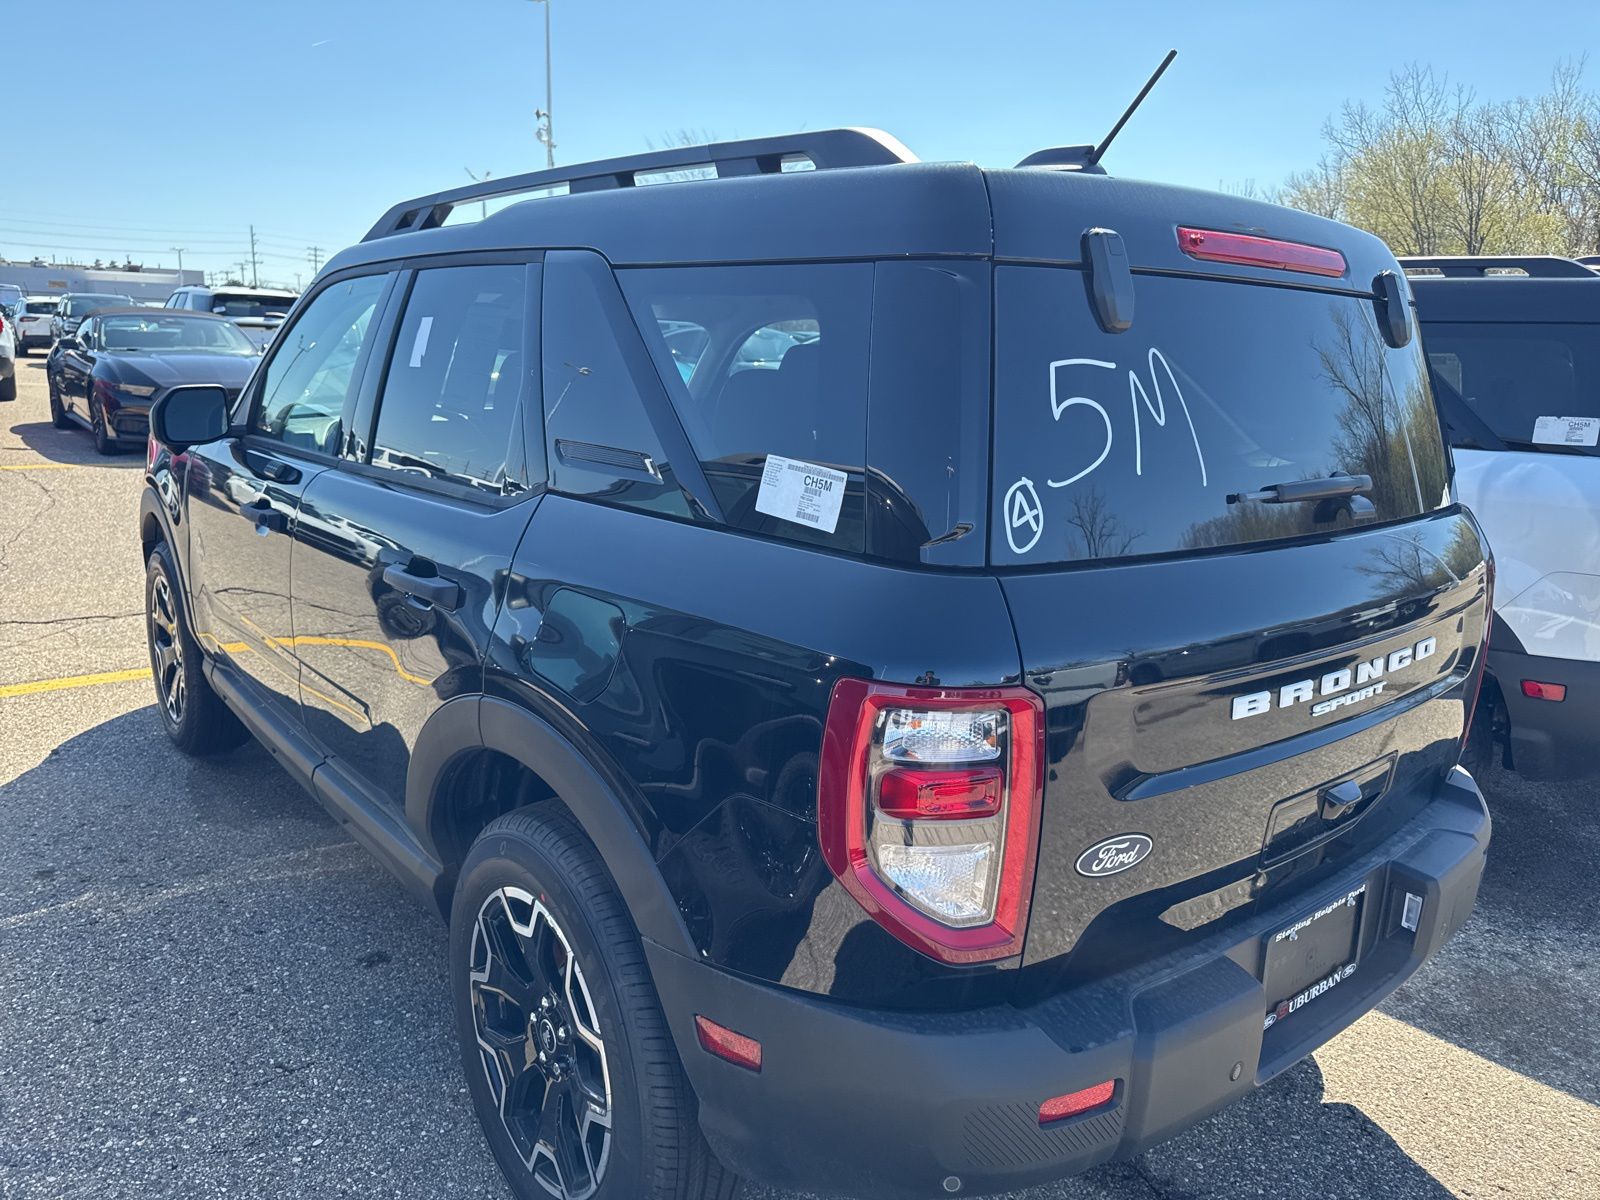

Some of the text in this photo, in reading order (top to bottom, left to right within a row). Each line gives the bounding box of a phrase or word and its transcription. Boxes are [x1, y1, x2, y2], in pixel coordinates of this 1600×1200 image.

[1047, 347, 1207, 488] 5M
[803, 475, 833, 492] CH5M
[1231, 636, 1437, 721] BRONCO
[1311, 681, 1387, 717] SPORT
[1275, 884, 1366, 942] Sterling Heights Ford
